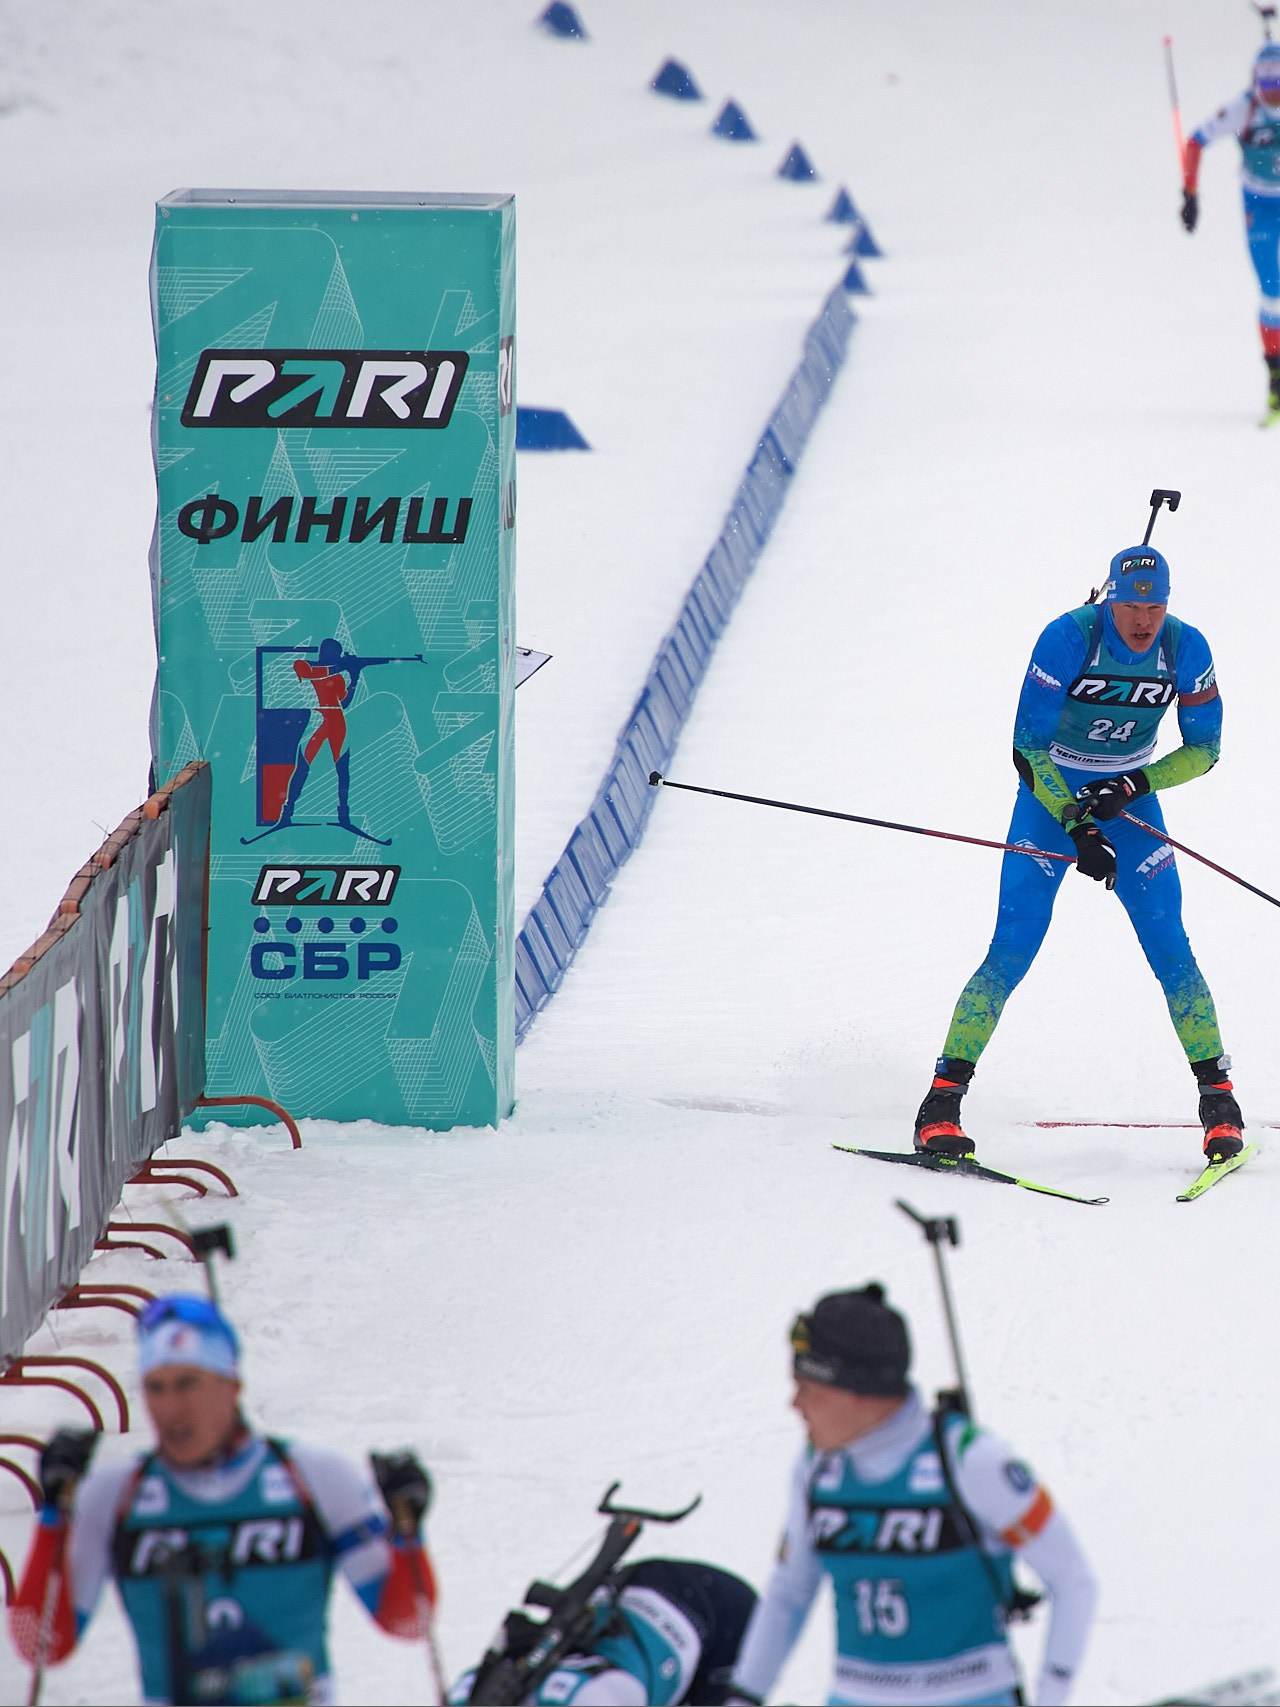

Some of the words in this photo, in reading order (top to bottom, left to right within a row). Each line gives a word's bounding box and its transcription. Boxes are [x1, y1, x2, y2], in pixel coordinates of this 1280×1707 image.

[192, 359, 456, 419] PARI
[177, 494, 473, 545] ФИНИШ
[1121, 558, 1155, 572] PARI
[1071, 678, 1173, 704] PARI
[1087, 718, 1137, 743] 24
[257, 869, 395, 902] PARI
[250, 942, 402, 981] СБР
[813, 1507, 944, 1550] PARI
[855, 1577, 909, 1639] 15
